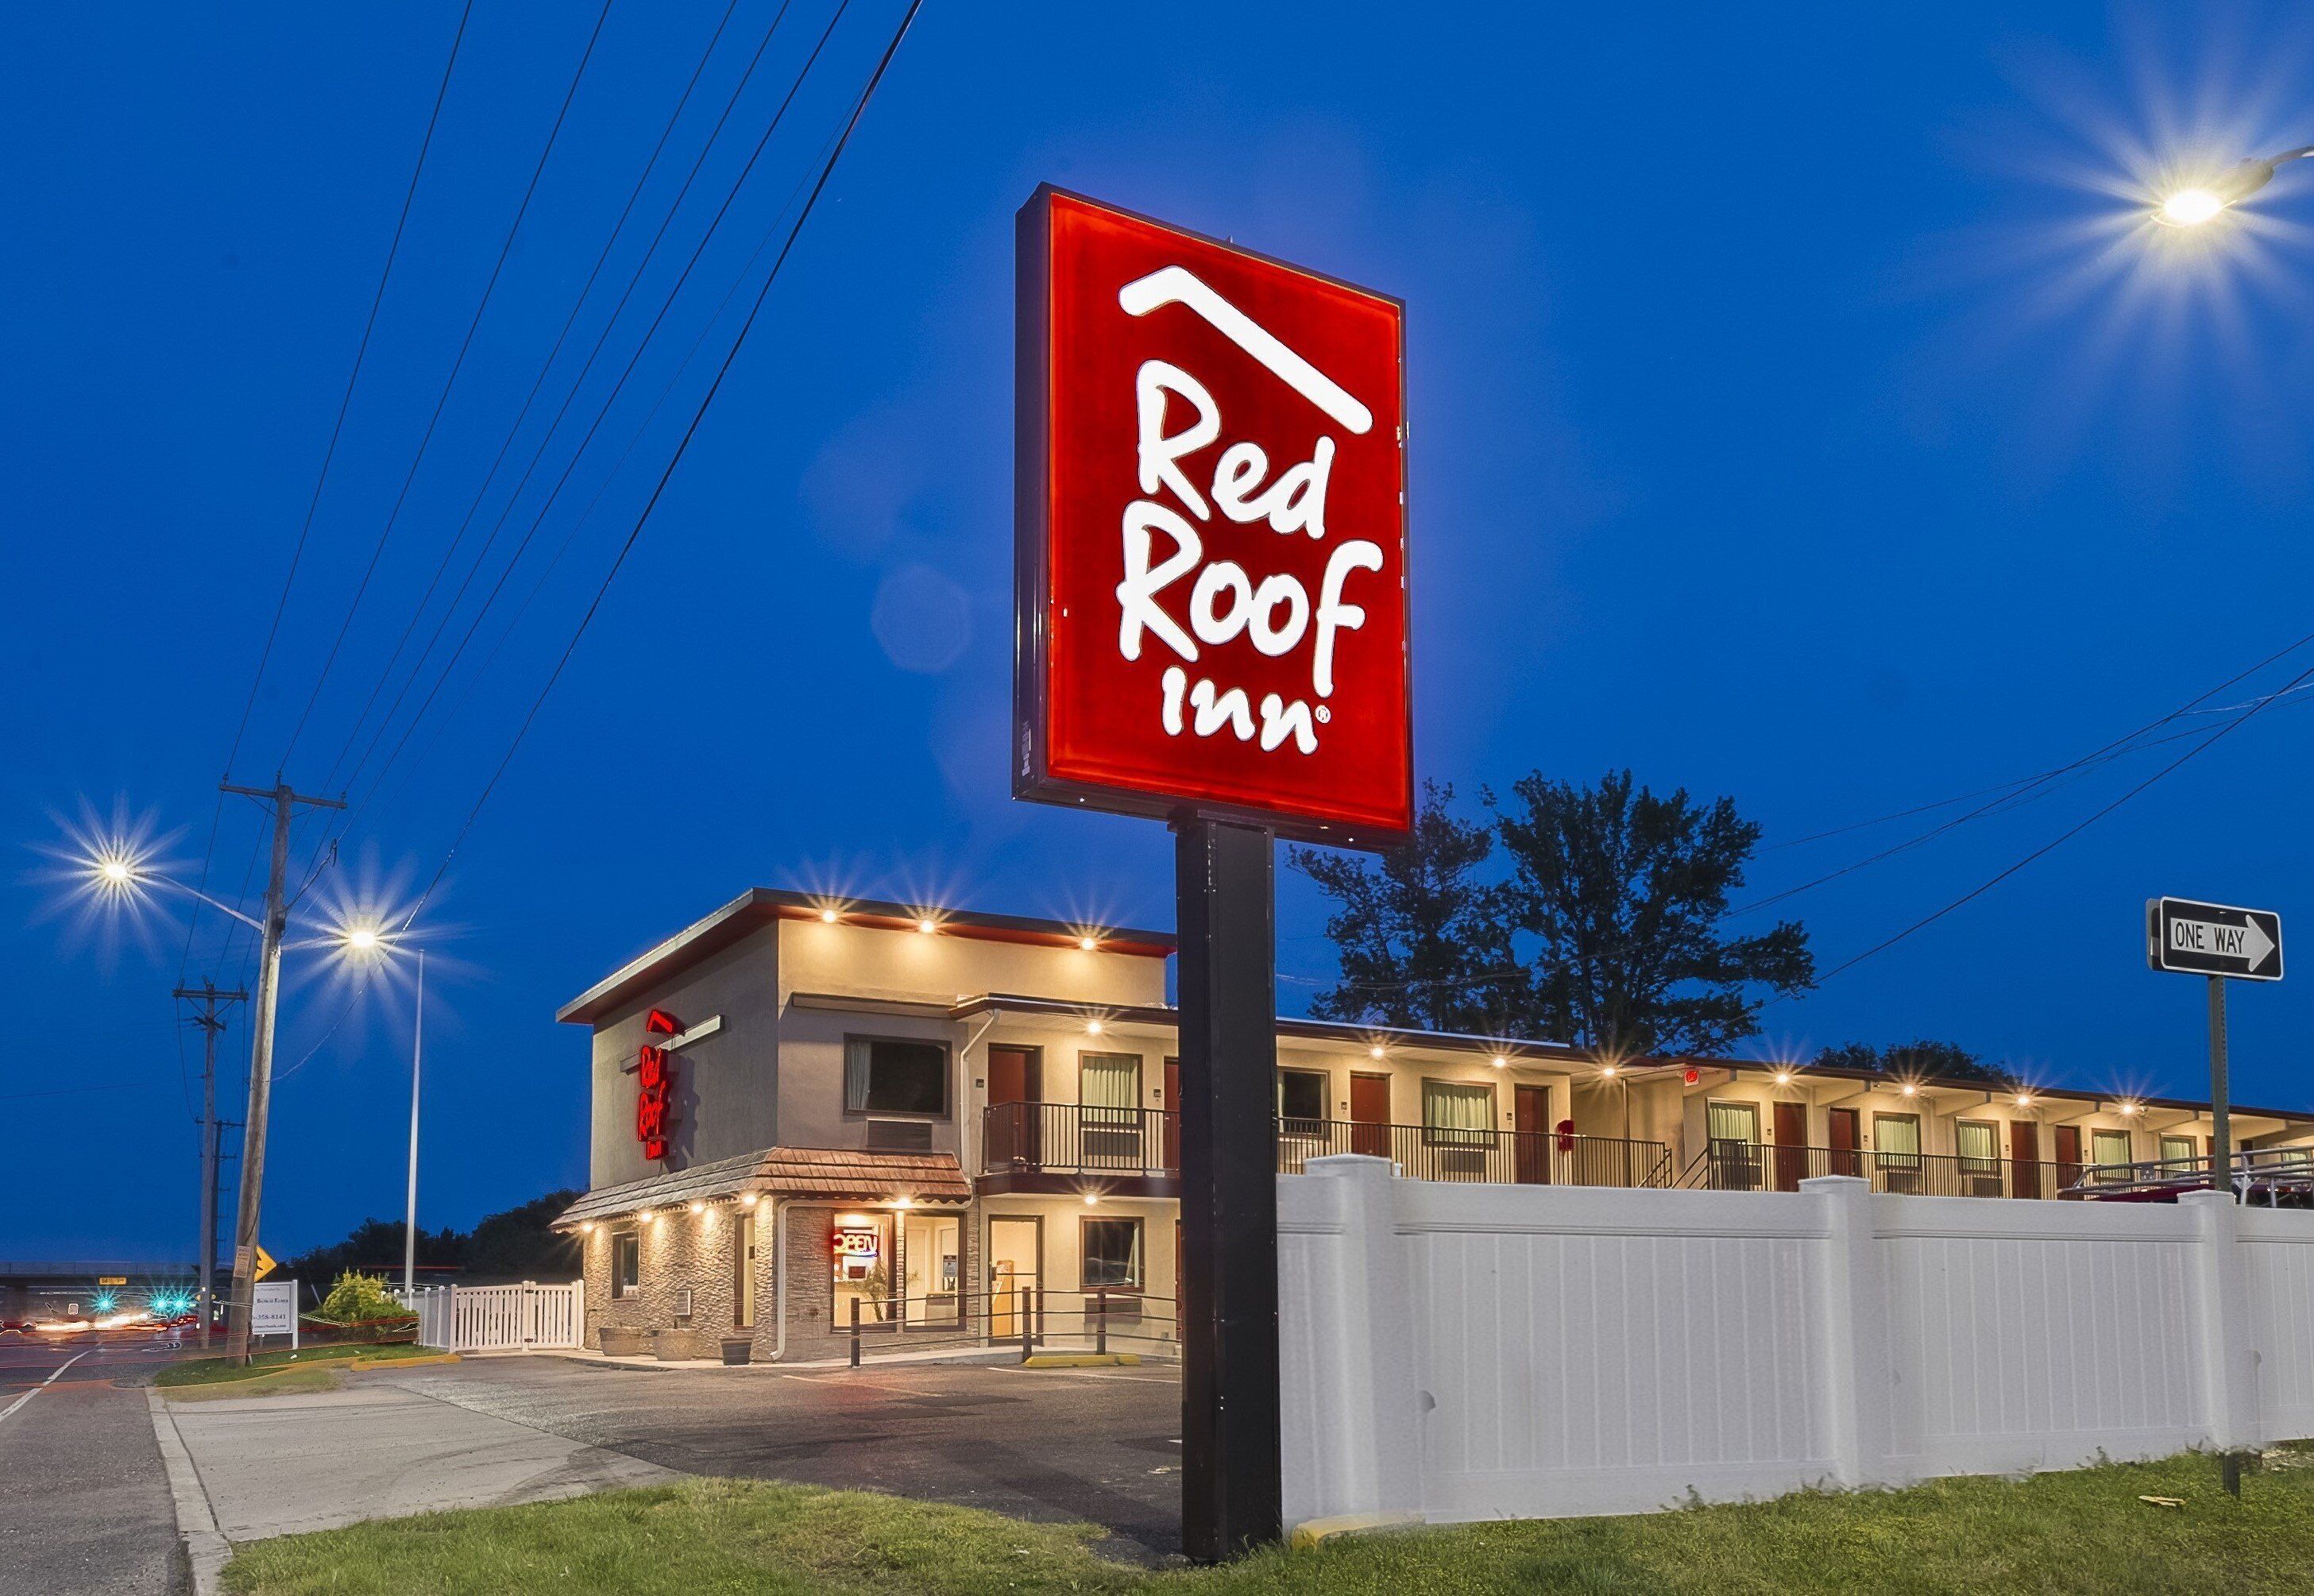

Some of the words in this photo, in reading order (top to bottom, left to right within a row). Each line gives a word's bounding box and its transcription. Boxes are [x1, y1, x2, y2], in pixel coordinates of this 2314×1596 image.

[1135, 358, 1336, 541] Red
[1115, 499, 1385, 699] Roof
[2175, 922, 2204, 950] ONE
[2213, 927, 2245, 954] WAY
[832, 1234, 878, 1253] OPEN
